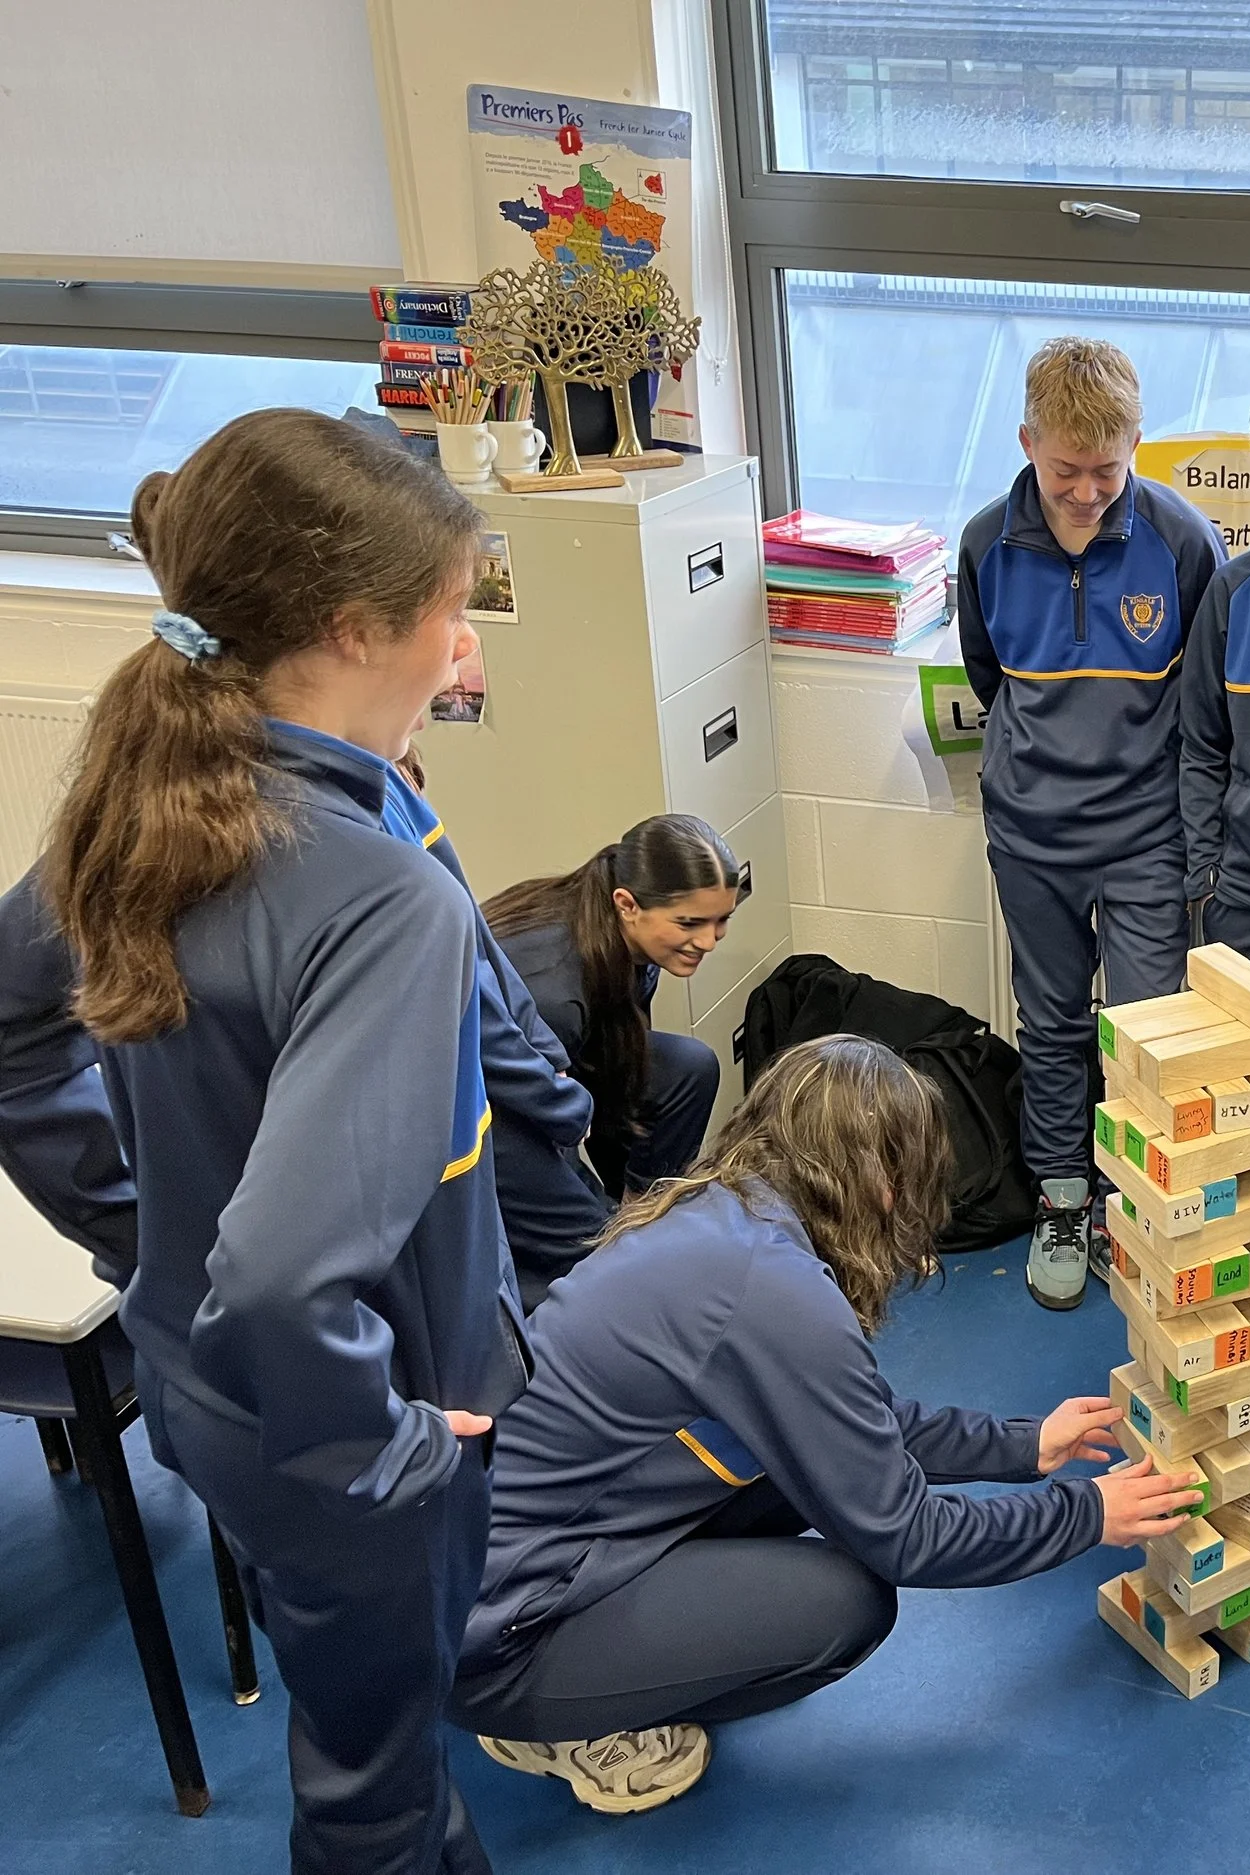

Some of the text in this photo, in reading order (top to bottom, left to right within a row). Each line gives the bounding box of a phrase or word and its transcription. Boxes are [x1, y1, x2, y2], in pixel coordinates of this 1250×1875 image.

[481, 94, 584, 128] Premiers Pas
[600, 119, 625, 131] French
[642, 125, 665, 137] Junior
[399, 300, 448, 314] Dictionary
[1221, 1104, 1249, 1118] AIR
[1204, 1188, 1236, 1208] Water
[1173, 1203, 1201, 1220] AIR
[1217, 1264, 1242, 1287] Land
[1194, 1549, 1223, 1572] Water
[1225, 1594, 1250, 1618] Land
[1200, 1664, 1212, 1687] AIR
